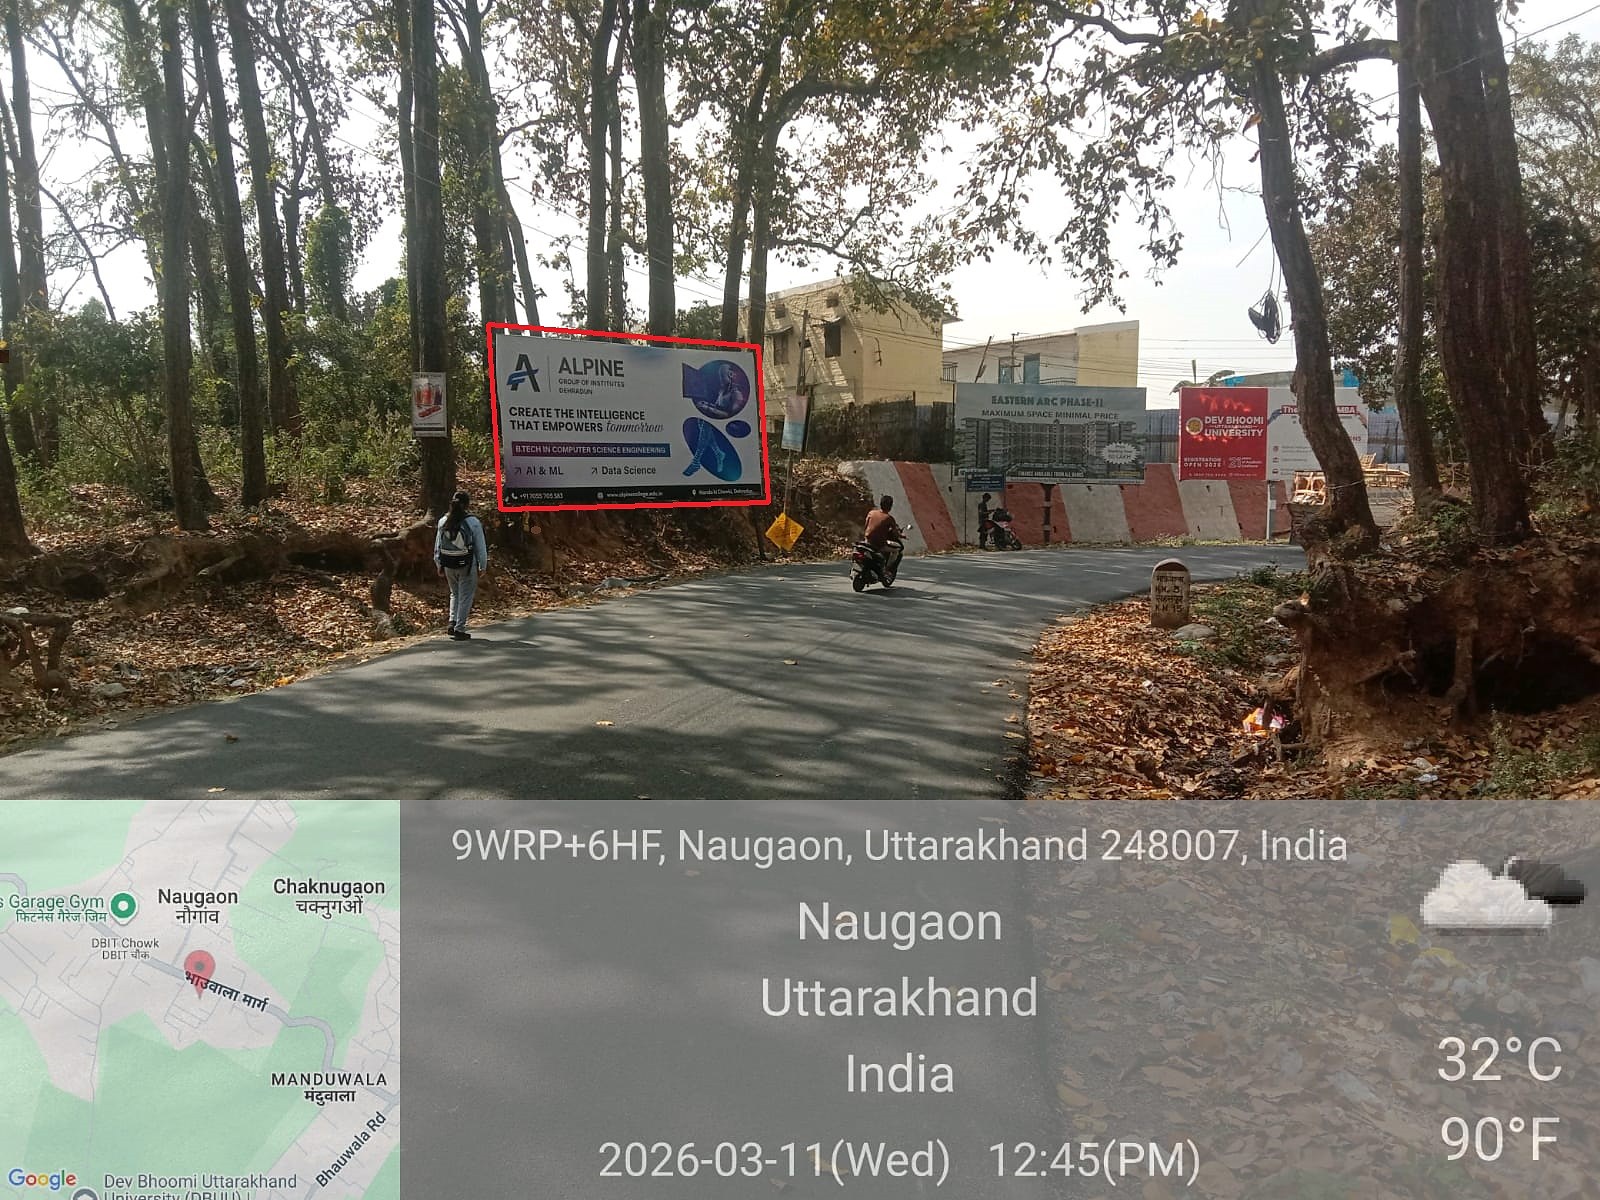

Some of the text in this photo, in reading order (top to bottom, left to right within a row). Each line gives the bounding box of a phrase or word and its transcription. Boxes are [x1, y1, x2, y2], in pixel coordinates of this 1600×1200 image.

[558, 357, 625, 378] ALPINE
[590, 380, 625, 388] INSTITUTES
[991, 395, 1035, 406] EASTERN
[1036, 396, 1058, 407] ARC
[508, 406, 646, 421] CREATE THE INTELLIGENCE
[981, 409, 1120, 420] MAXIMUM SPACE MINIMAL PRICE
[1204, 416, 1264, 425] DEV BHOOMI
[509, 420, 541, 432] THAT
[542, 421, 603, 433] EMPOWERS
[1204, 429, 1264, 437] UNIVERSITY
[543, 446, 551, 454] IN
[552, 446, 592, 454] COMPUTER
[592, 446, 622, 455] SCIENCE
[622, 447, 666, 455] ENGINEERING
[526, 466, 564, 475] AI & ML
[601, 466, 657, 475] Data Science
